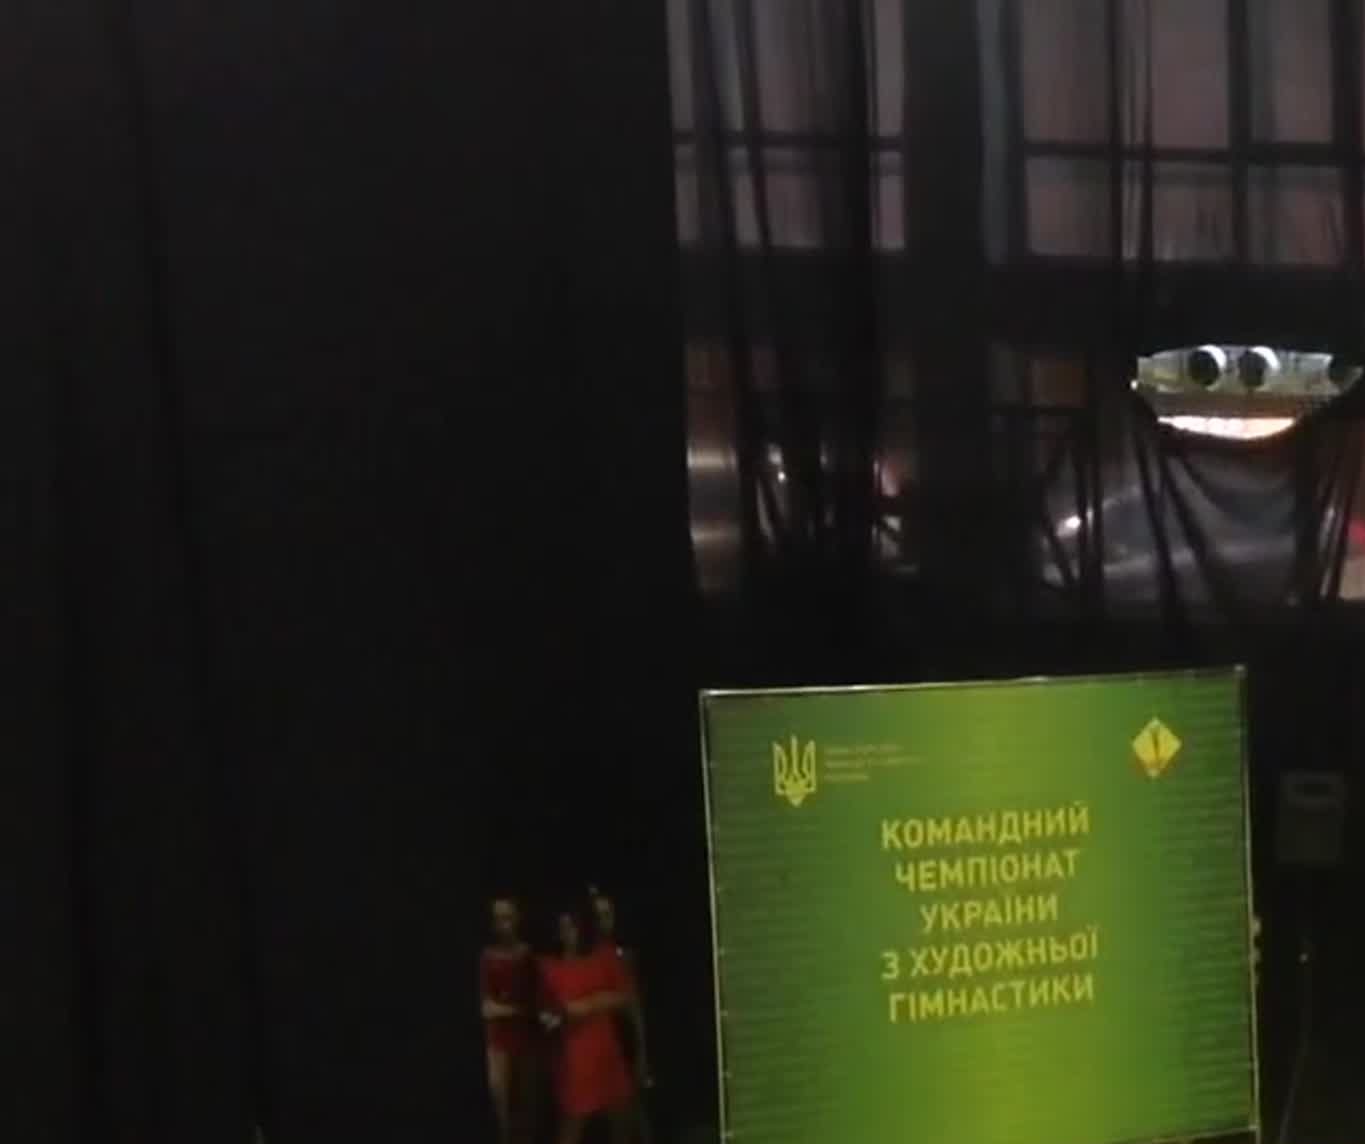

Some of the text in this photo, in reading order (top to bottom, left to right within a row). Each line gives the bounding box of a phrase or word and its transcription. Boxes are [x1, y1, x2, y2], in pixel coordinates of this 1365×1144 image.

[881, 801, 1089, 849] КОМАНДНИЙ
[895, 850, 1080, 892] ЧЕМПІОНАТ
[910, 923, 1099, 978] ХУДОЖНЬОЇ
[889, 973, 1094, 1022] ГІМНАСТИКИ
